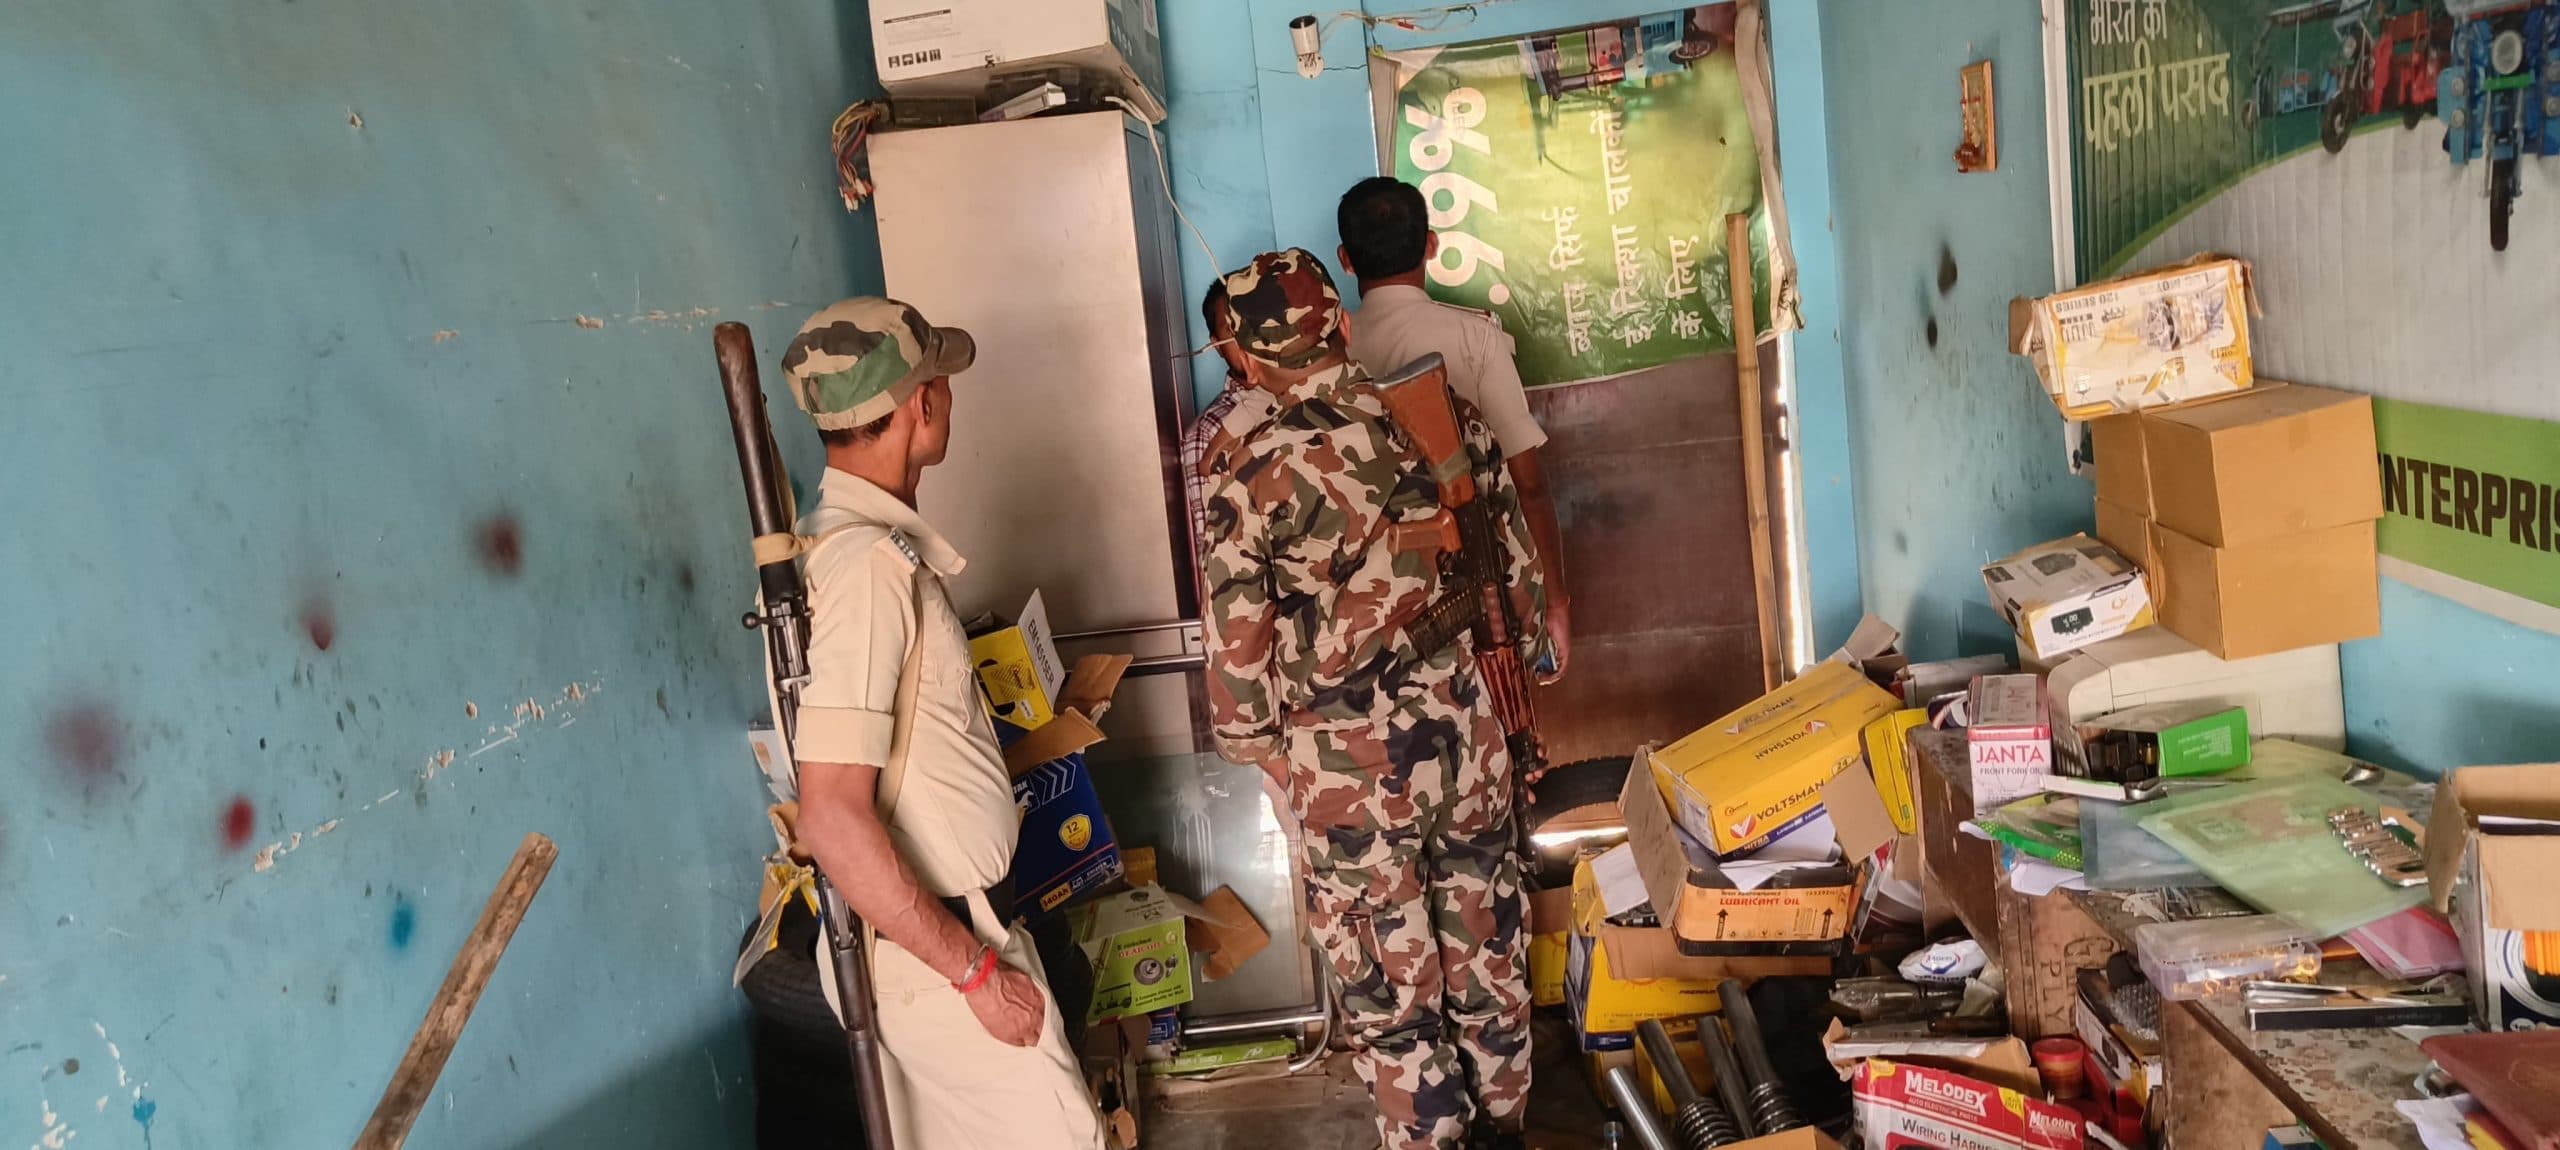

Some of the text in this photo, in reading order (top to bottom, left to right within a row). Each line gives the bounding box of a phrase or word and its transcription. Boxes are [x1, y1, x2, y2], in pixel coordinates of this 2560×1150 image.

[2083, 36, 2231, 151] पहली पसंद
[1590, 110, 1656, 348] ई रिक्शा चालकों
[1541, 205, 1593, 357] ब्याज सिर्फ
[1664, 235, 1703, 340] के लिए
[2378, 452, 2560, 554] NTERPRI
[1755, 730, 1809, 760] VOLTSMAN
[1976, 744, 2045, 764] JANTA
[1979, 767, 2004, 776] FRONT
[1756, 780, 1825, 821] VOLTSMAN
[1066, 821, 1080, 834] 12
[1719, 897, 1801, 906] LUBRICANT OIL
[1904, 1070, 1986, 1116] MELODEX
[1902, 1117, 2000, 1150] WIRING HARN
[2029, 1109, 2077, 1140] MELODEX
